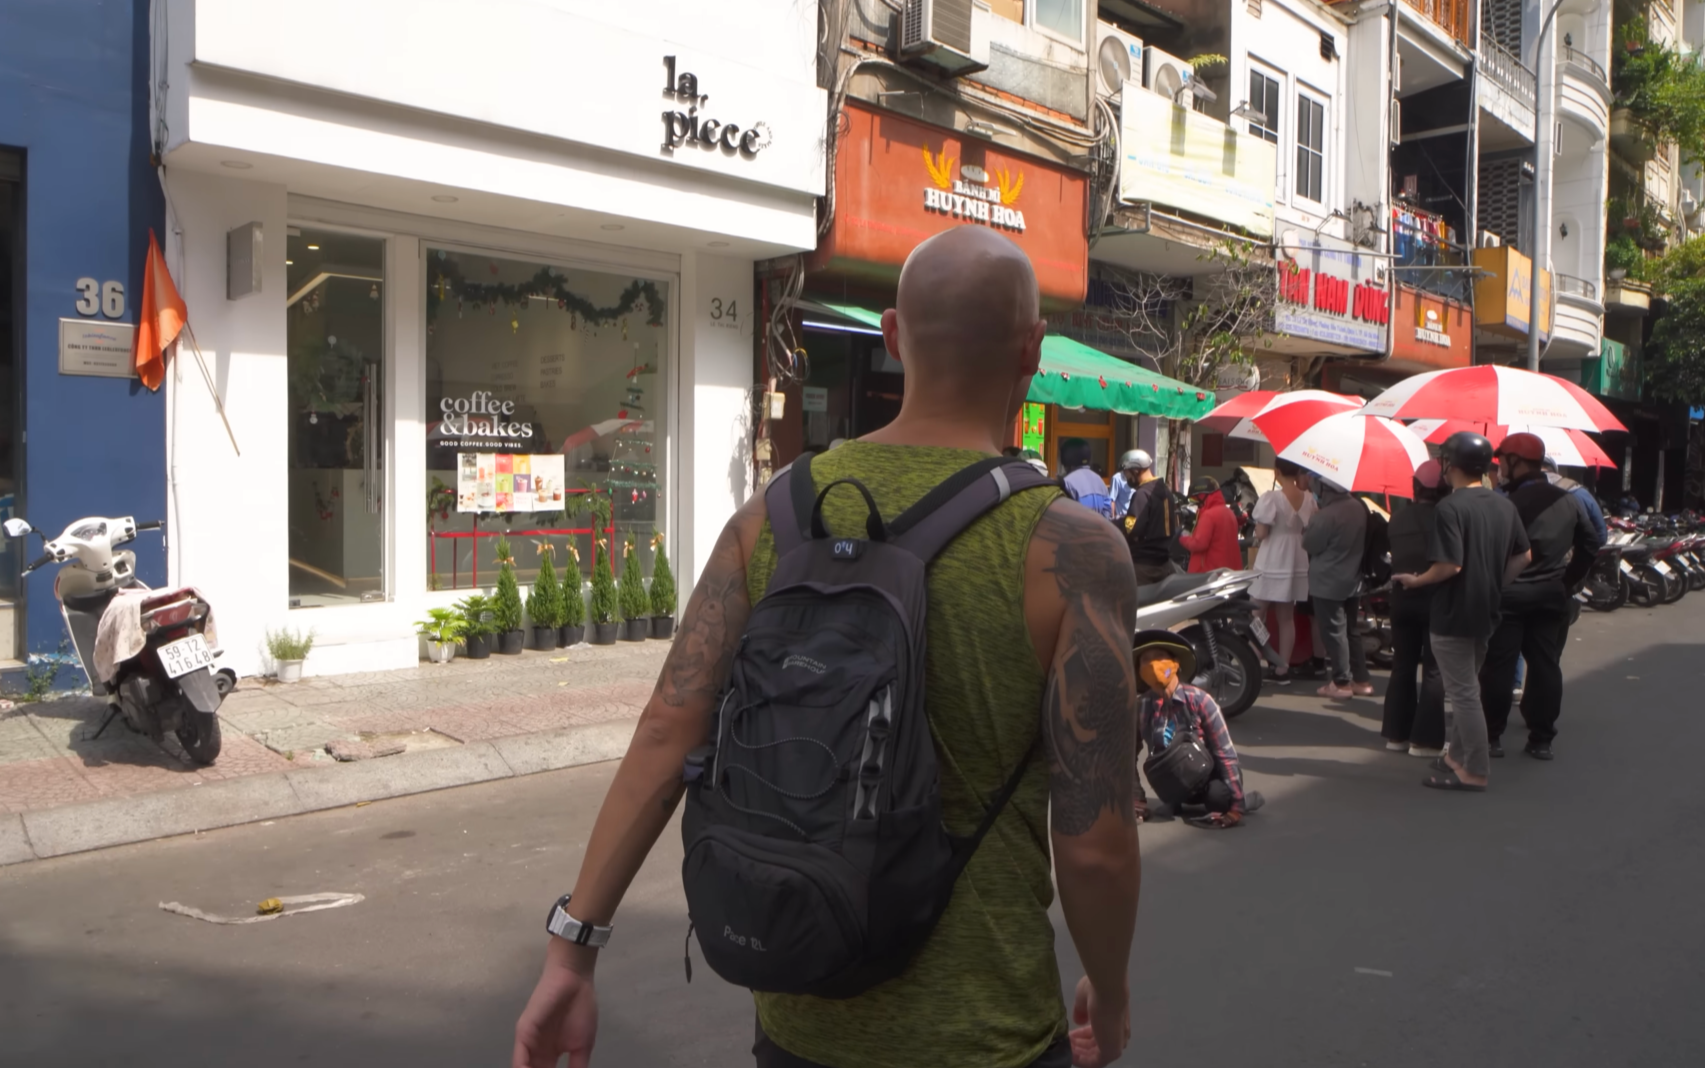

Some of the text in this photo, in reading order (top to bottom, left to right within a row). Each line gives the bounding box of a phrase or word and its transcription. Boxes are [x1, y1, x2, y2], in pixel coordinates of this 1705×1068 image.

[924, 187, 1027, 232] HUYNH HOA
[76, 277, 125, 319] 36
[710, 297, 738, 322] 34
[440, 390, 515, 415] coffee
[440, 412, 533, 438] &bakes
[165, 639, 201, 660] 59-T2
[168, 650, 211, 675] 416.48
